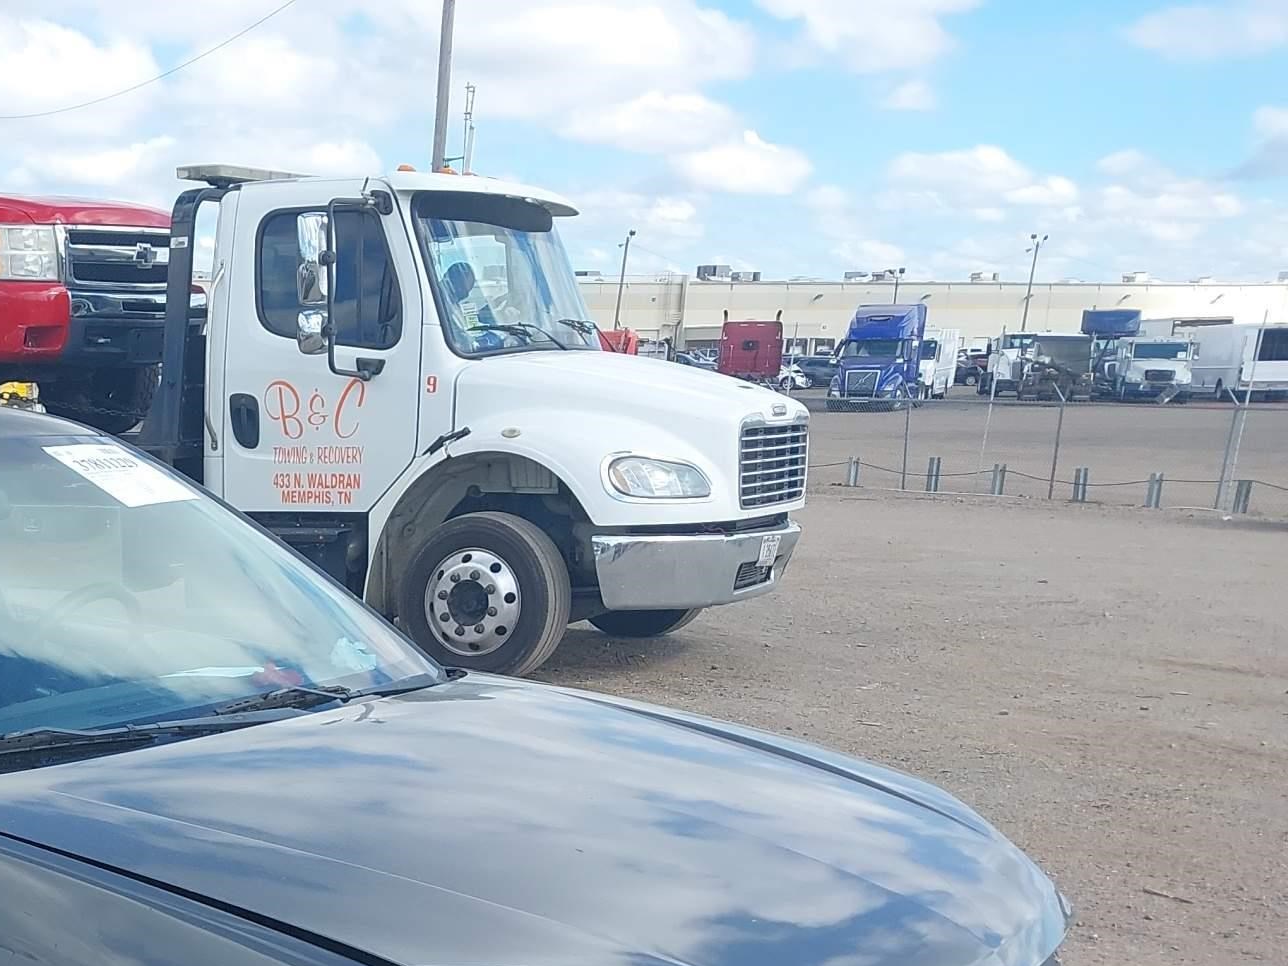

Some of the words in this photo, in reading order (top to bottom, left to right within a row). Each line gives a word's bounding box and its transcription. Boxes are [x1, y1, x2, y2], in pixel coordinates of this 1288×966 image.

[426, 375, 438, 394] 9
[264, 380, 304, 440] B
[308, 388, 329, 431] &
[334, 378, 365, 439] C
[272, 446, 307, 465] TOWING
[317, 446, 365, 465] RECOVERY
[273, 473, 291, 489] 433
[294, 473, 305, 489] N.
[307, 473, 361, 489] WALDRAN
[281, 490, 335, 507] MEMPHIS,
[337, 491, 352, 505] TN
